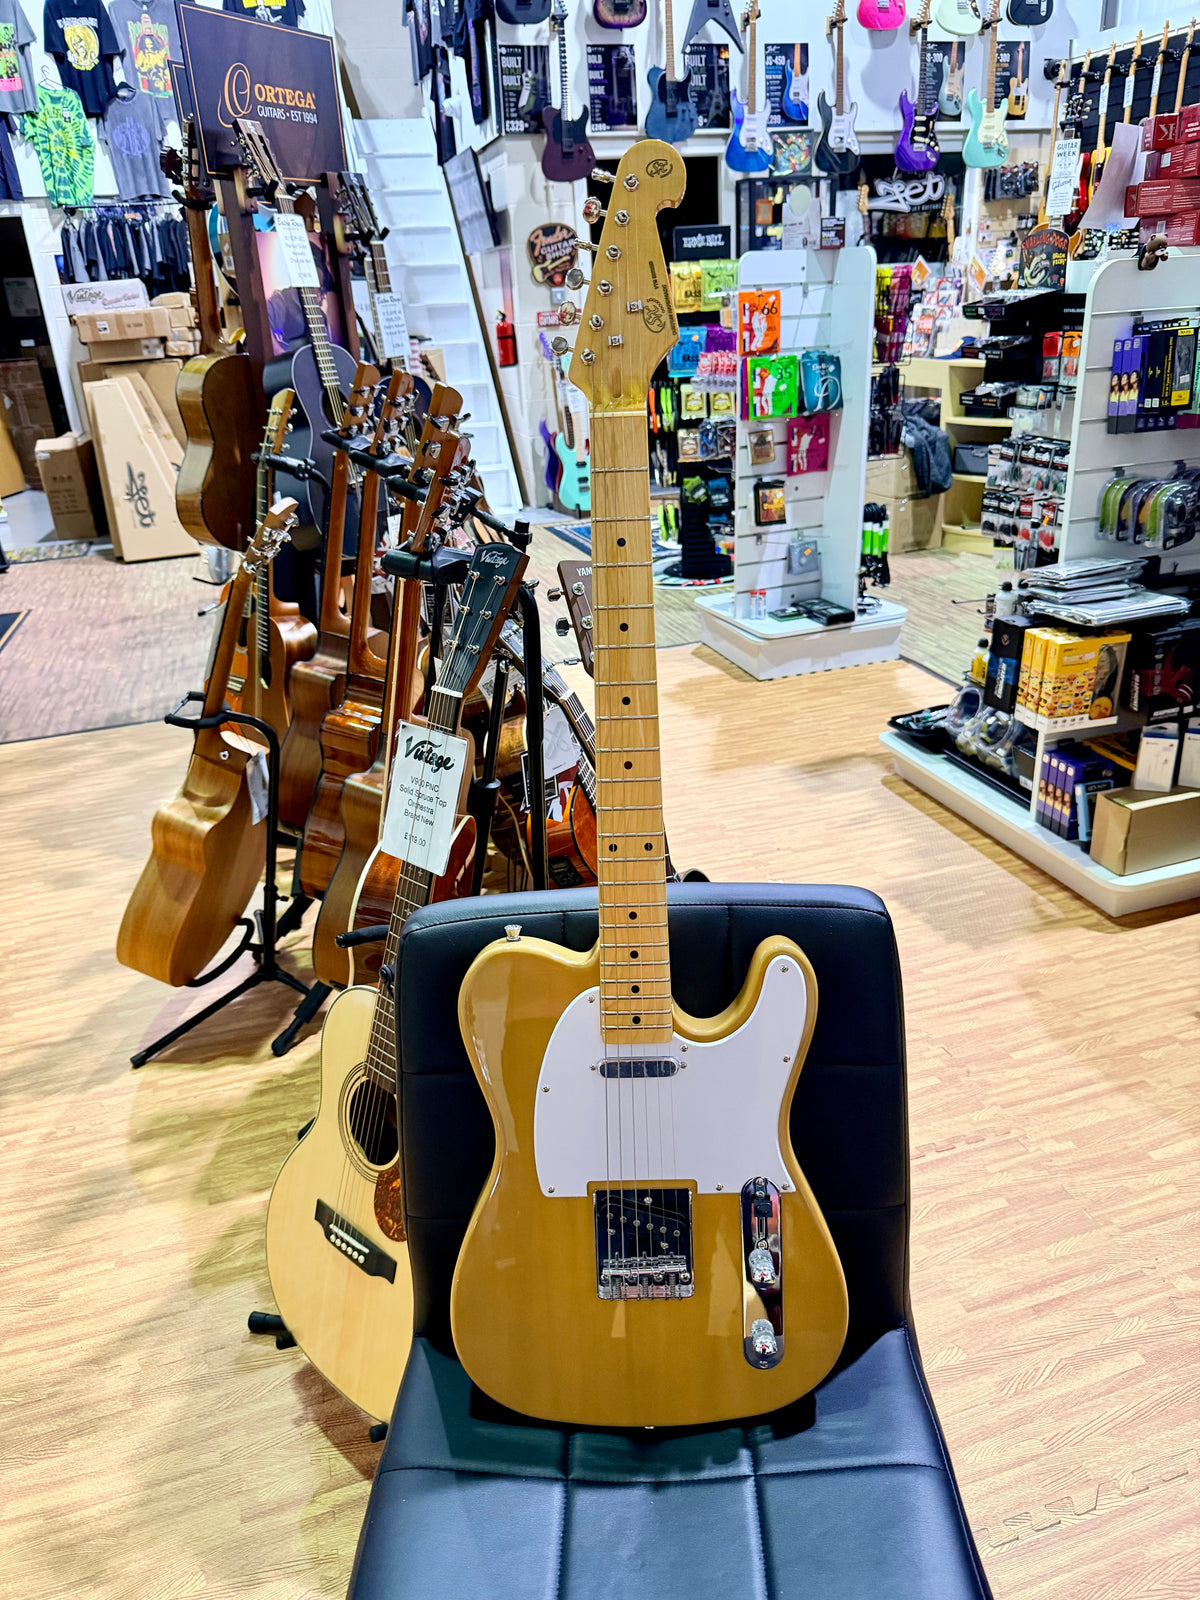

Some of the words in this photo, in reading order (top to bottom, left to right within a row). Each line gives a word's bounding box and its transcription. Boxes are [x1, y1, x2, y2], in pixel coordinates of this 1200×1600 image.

[501, 56, 521, 67] BUILT
[925, 53, 943, 62] S-300
[503, 75, 521, 86] BUILT
[692, 75, 706, 86] UILT
[254, 83, 316, 110] ORTEGA
[257, 105, 286, 120] GUITARS
[290, 110, 301, 122] EST
[302, 111, 318, 124] 1994
[1057, 142, 1078, 150] GUITAR
[66, 287, 104, 304] Vintage
[761, 302, 778, 316] 66
[776, 366, 793, 380] 35
[480, 549, 510, 569] Vintage
[576, 566, 592, 577] YAM
[405, 735, 455, 773] Vintage
[400, 784, 413, 796] Solid
[415, 789, 434, 803] Spruce
[435, 796, 447, 808] Top
[404, 808, 420, 821] Brand
[421, 815, 434, 827] New
[404, 832, 426, 847] £19.00
